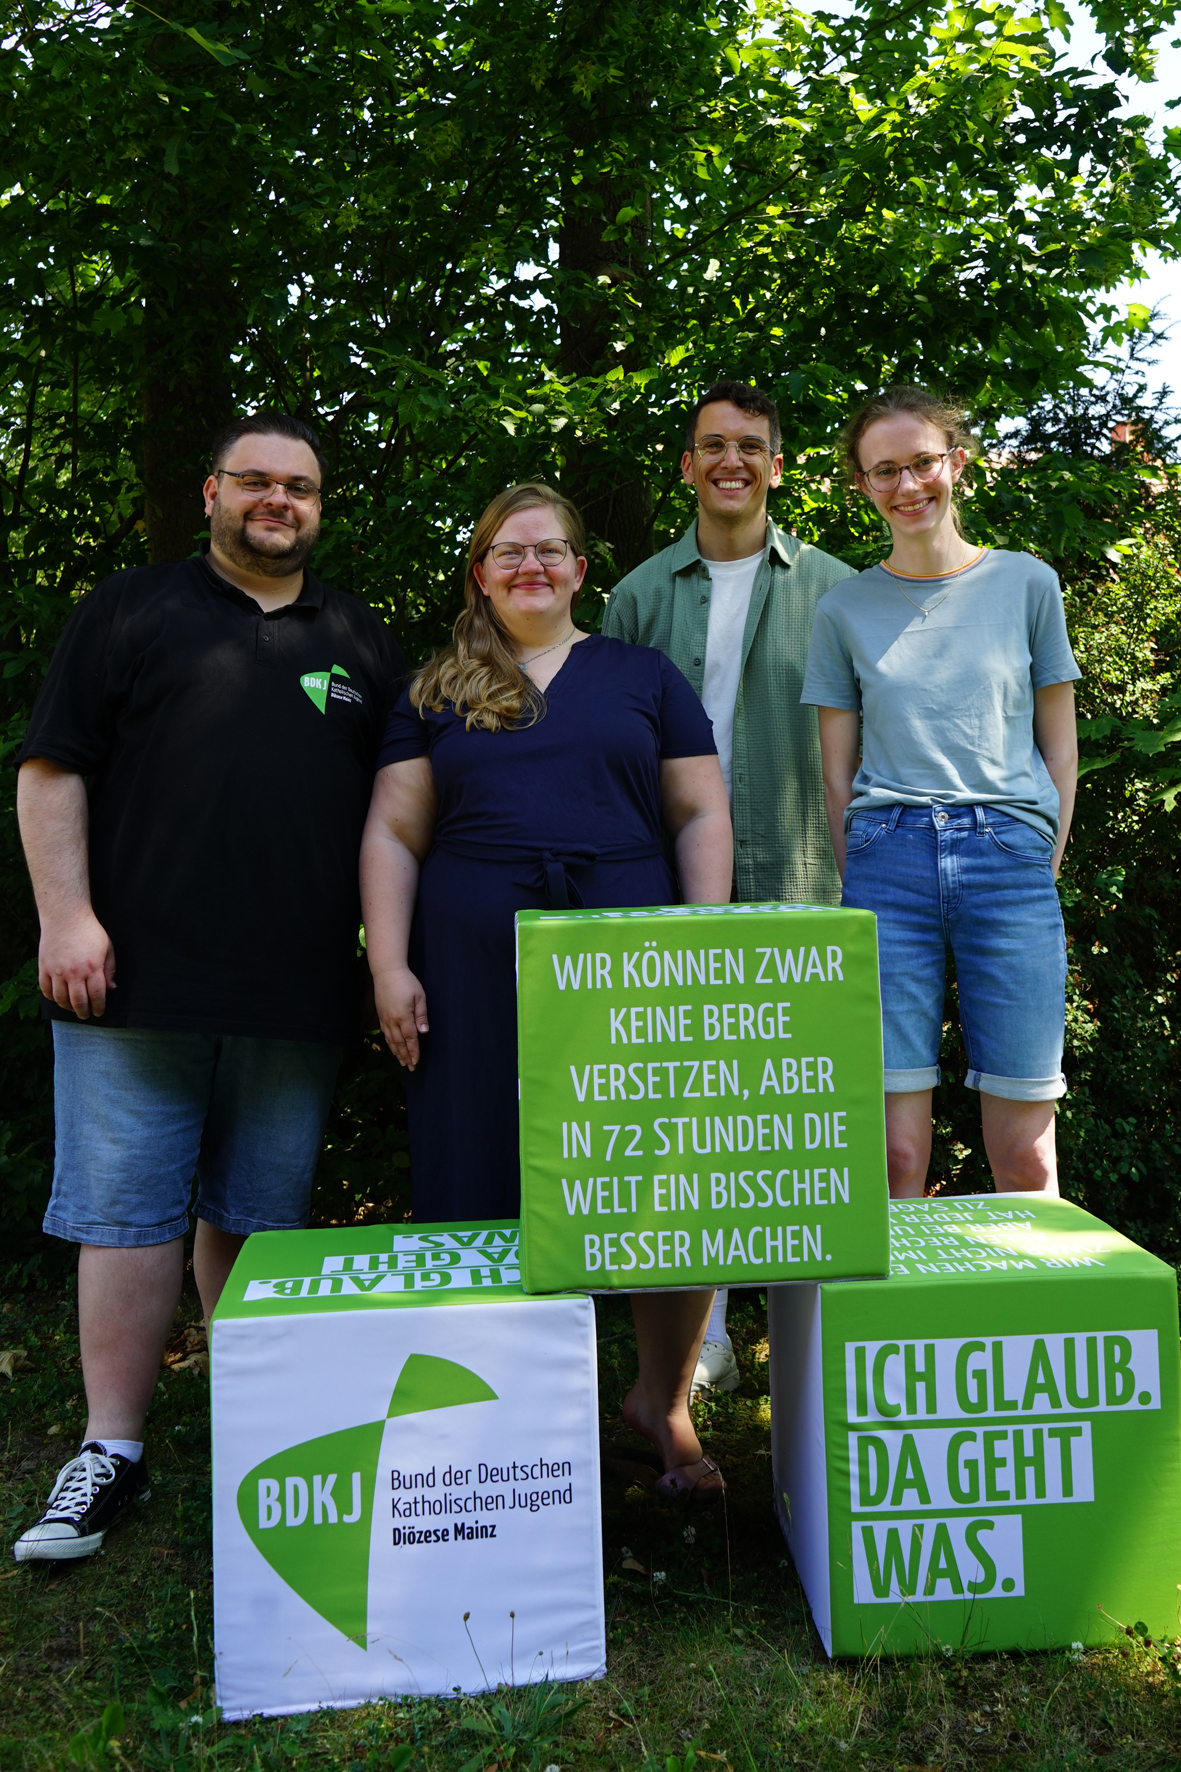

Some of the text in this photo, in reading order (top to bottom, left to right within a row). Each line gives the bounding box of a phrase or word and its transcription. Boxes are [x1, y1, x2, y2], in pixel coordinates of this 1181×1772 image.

[304, 676, 327, 690] BDKJ
[552, 941, 844, 991] WIR KÖNNEN ZWAR
[609, 1002, 792, 1045] KEINE BERGE
[569, 1056, 835, 1102] VERSETZEN, ABER
[561, 1111, 848, 1162] IN 72 STUNDEN DIE
[561, 1167, 850, 1216] WELT EIN BISSCHEN
[952, 1201, 991, 1210] ZU
[900, 1212, 974, 1223] JEDER
[919, 1224, 963, 1235] BEI
[965, 1221, 1032, 1233] ABER
[986, 1210, 1037, 1221] HAT
[584, 1224, 832, 1272] BESSER MACHEN.
[889, 1232, 1047, 1248] ALLEN RECH
[936, 1246, 1019, 1260] NICHT
[1020, 1243, 1112, 1256] ZWAR
[330, 1251, 462, 1274] GEHT
[890, 1256, 1106, 1275] WIR MACHEN E
[257, 1271, 453, 1297] GLAUB.
[854, 1335, 1153, 1418] ICH GLAUB.
[391, 1457, 573, 1491] Bund der Deutschen
[857, 1425, 1083, 1508] DA GEHT
[257, 1471, 362, 1530] BDKJ
[391, 1483, 573, 1519] Katholischen Jugend
[392, 1519, 497, 1547] Diözese Mainz
[861, 1519, 1016, 1599] WAS.
